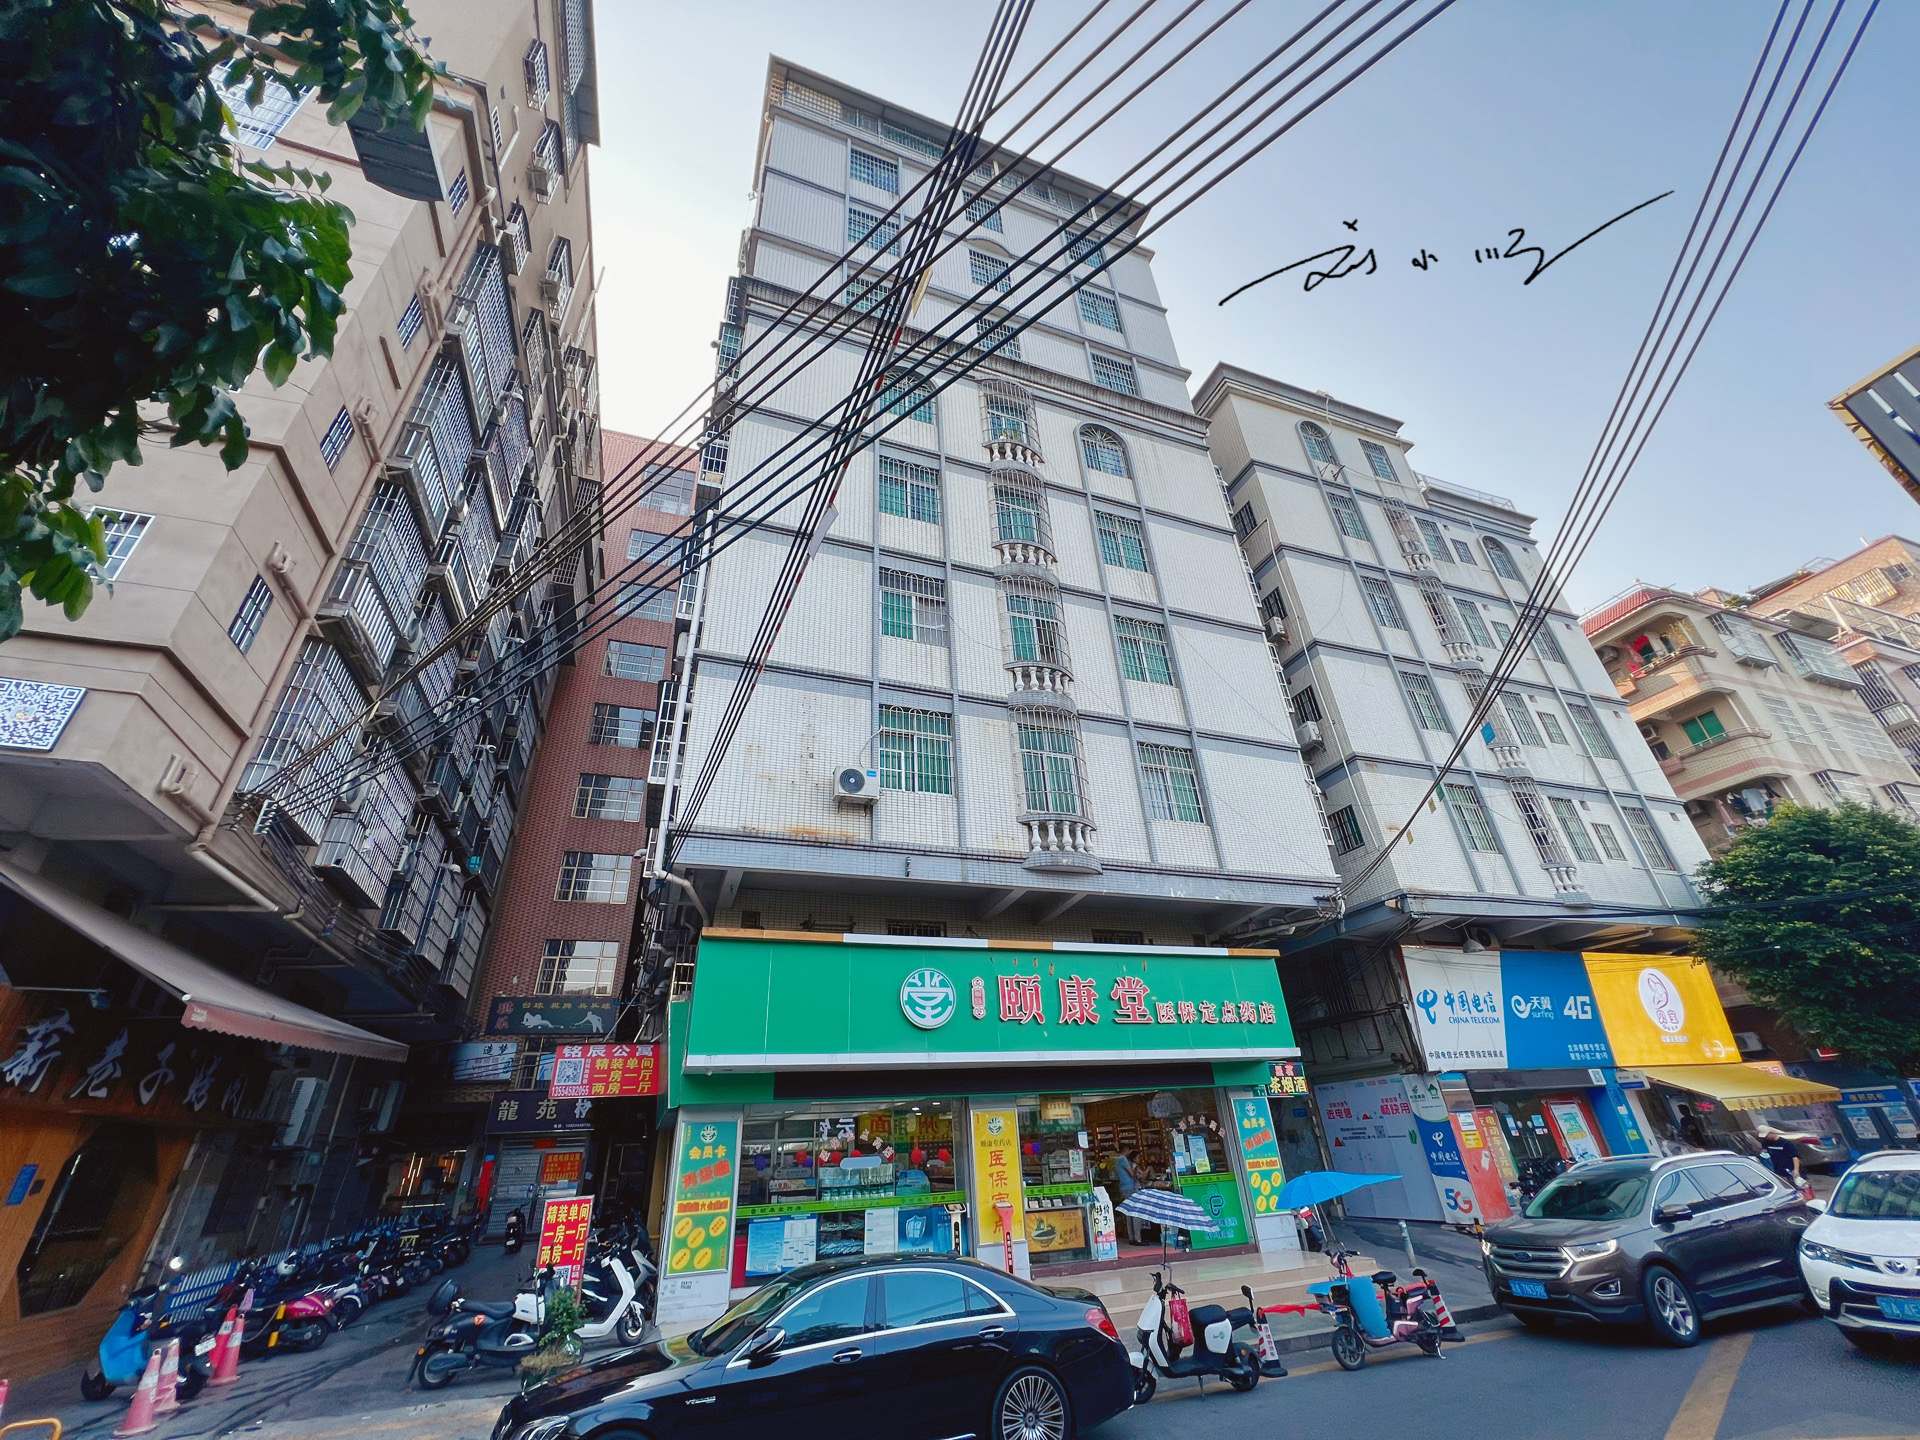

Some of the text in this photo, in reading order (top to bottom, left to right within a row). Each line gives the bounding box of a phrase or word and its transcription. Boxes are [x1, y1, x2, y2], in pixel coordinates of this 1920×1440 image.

[998, 974, 1153, 1025] 颐康堂
[1155, 1001, 1277, 1025] 医保定点药店
[1443, 989, 1497, 1015] 中国电信
[1530, 996, 1552, 1010] 天翼
[1531, 1010, 1554, 1020] surfing
[1563, 995, 1592, 1020] 4G
[1448, 1016, 1500, 1024] CHINA TELECOM
[563, 1044, 654, 1058] 铭辰公寓
[595, 1058, 654, 1070] 精装单间
[594, 1070, 653, 1082] 一房一厅
[591, 1082, 652, 1095] 两房一厅
[1270, 1076, 1307, 1093] 茶烟酒
[1430, 1151, 1459, 1161] 中国电信
[1444, 1188, 1473, 1214] 5G
[546, 1203, 590, 1224] 精装单间
[544, 1223, 587, 1243] 一房一厅
[540, 1243, 585, 1265] 两房一厅
